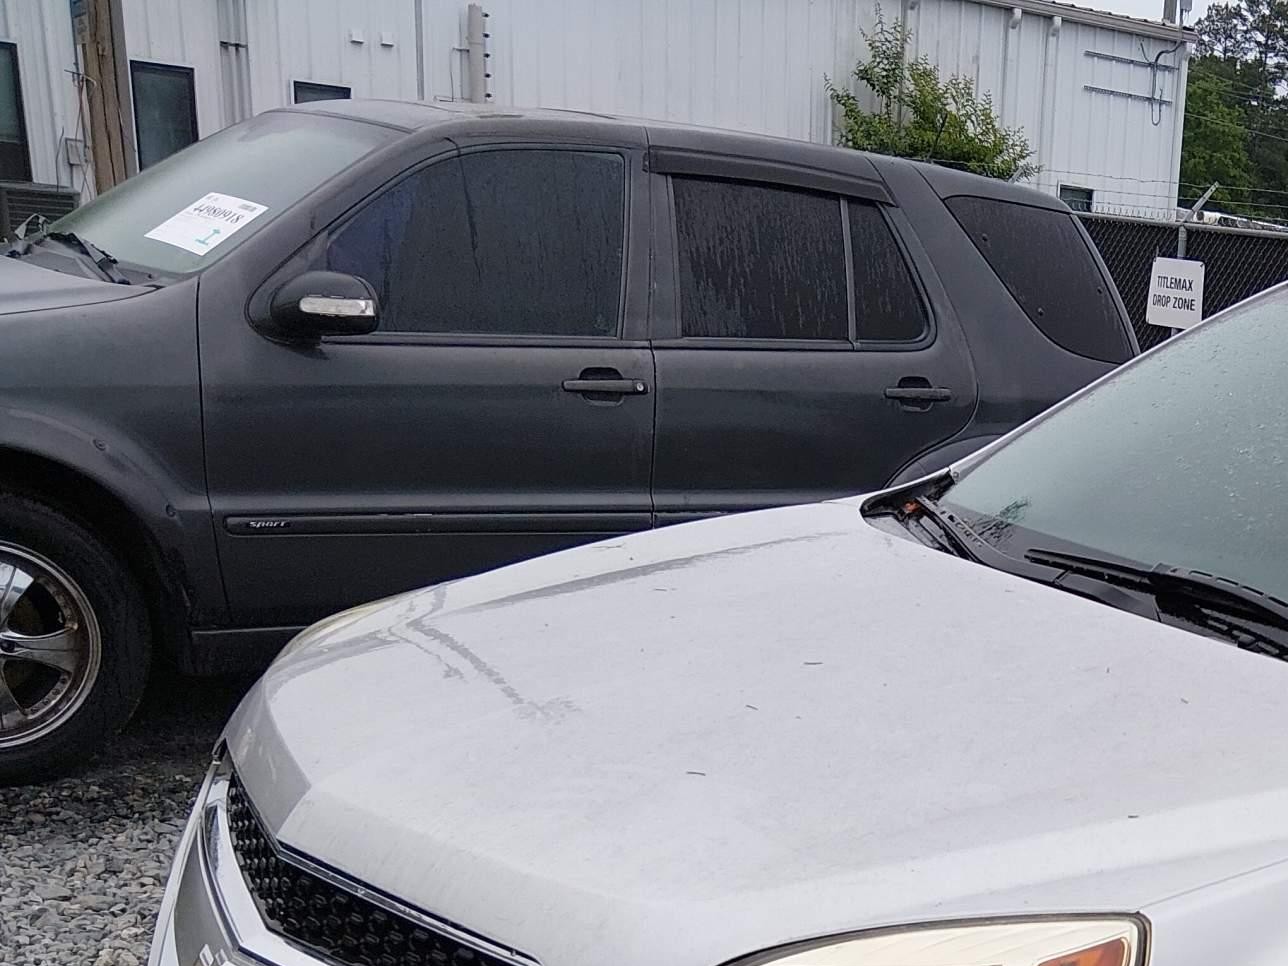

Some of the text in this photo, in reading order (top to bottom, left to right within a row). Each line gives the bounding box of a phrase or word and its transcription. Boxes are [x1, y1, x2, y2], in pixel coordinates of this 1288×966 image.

[1157, 275, 1194, 292] TITLEMAX
[1152, 293, 1196, 312] DROP ZONE
